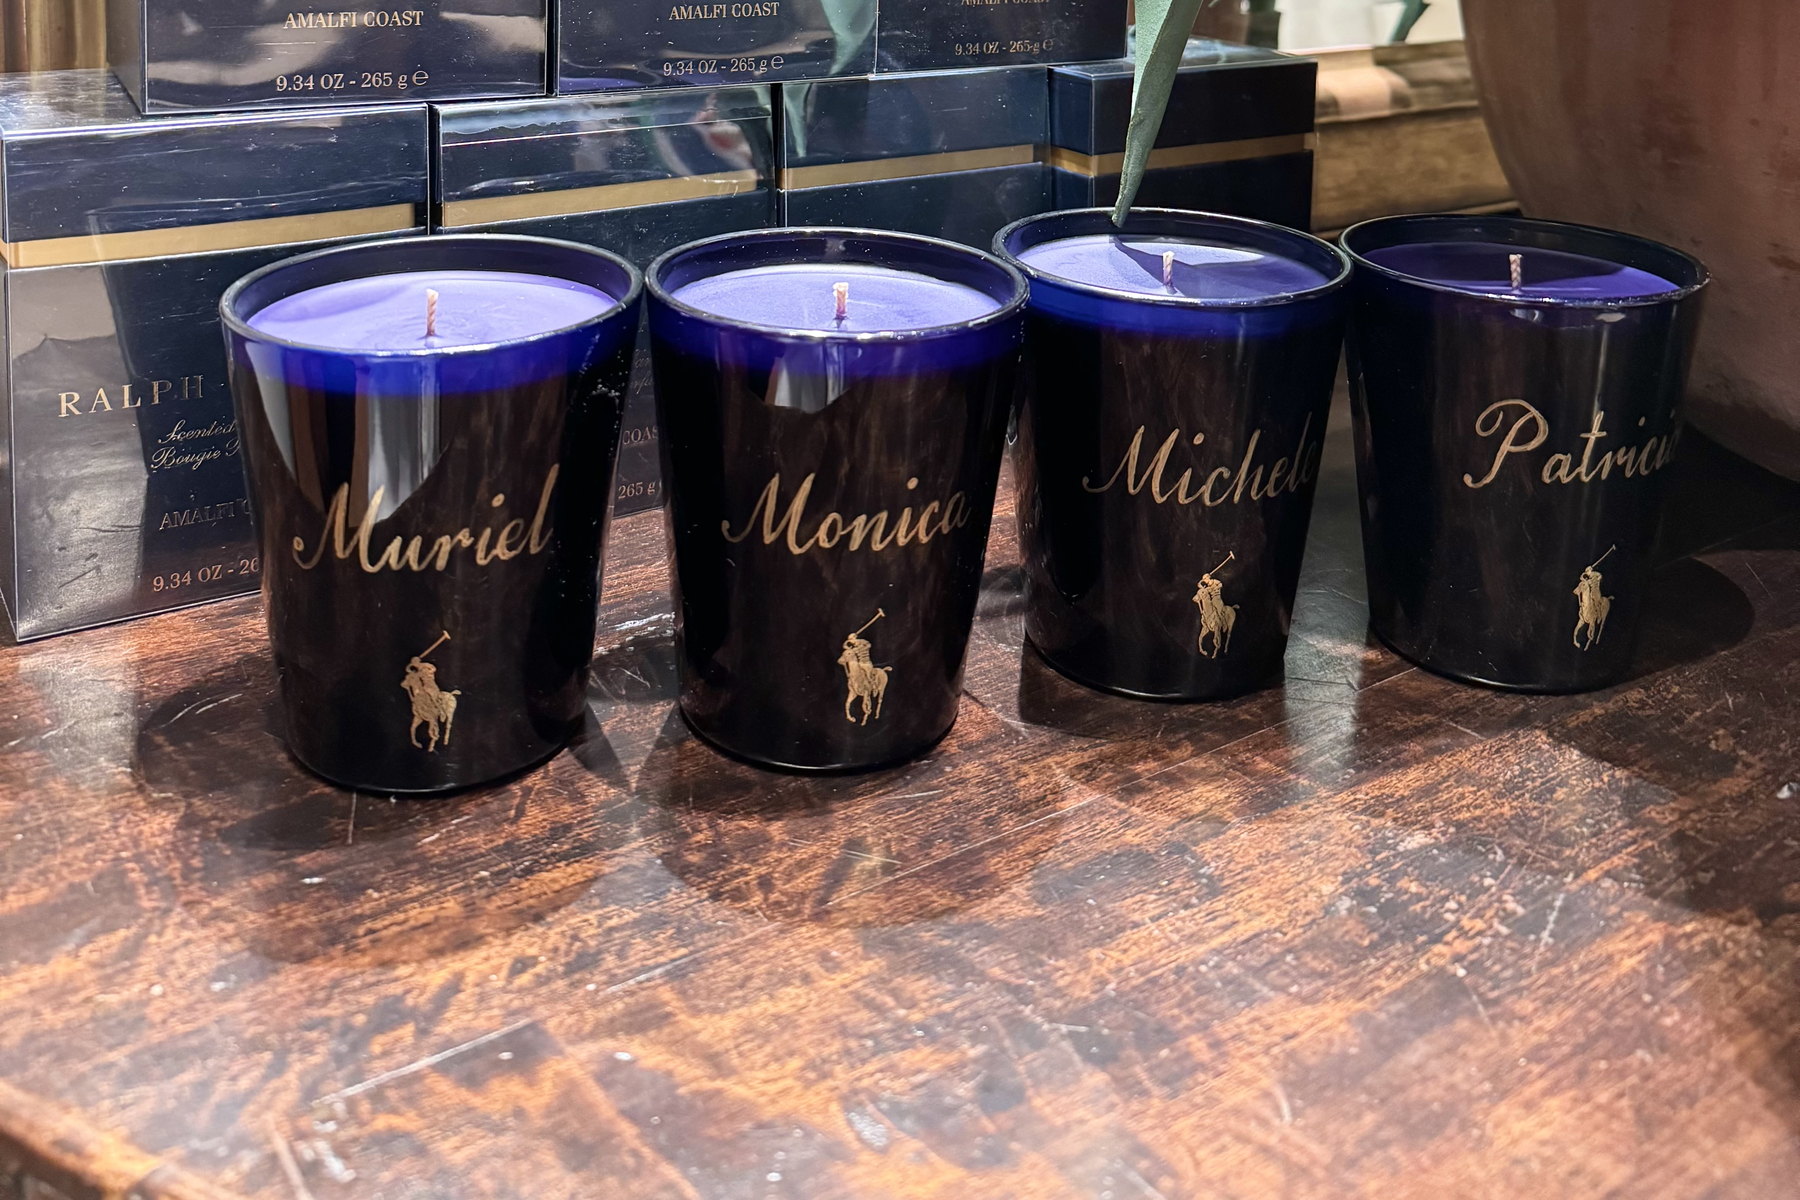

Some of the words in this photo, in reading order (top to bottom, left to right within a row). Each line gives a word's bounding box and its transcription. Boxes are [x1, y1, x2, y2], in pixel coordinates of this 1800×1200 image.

[283, 12, 358, 30] AMALFI
[362, 10, 424, 27] COAST
[668, 3, 727, 21] AMALFI
[731, 1, 780, 19] COAST
[954, 42, 980, 57] 9.34
[983, 41, 1000, 55] OZ
[1009, 40, 1031, 54] 265
[663, 60, 695, 77] 9.34
[698, 59, 718, 74] OZ
[730, 57, 756, 72] 265
[275, 73, 315, 93] 9.34
[320, 72, 345, 90] OZ
[360, 71, 394, 89] 265
[58, 374, 205, 418] RALPH
[157, 418, 238, 445] Scented
[622, 425, 659, 446] COAS
[150, 446, 222, 471] Bougie
[617, 481, 644, 500] 265
[647, 479, 657, 496] g
[158, 501, 236, 531] AMALFI
[292, 463, 560, 574] Muriel
[721, 472, 972, 556] Monica
[152, 570, 193, 592] 9.34
[197, 563, 224, 584] OZ
[239, 558, 260, 576] 26
